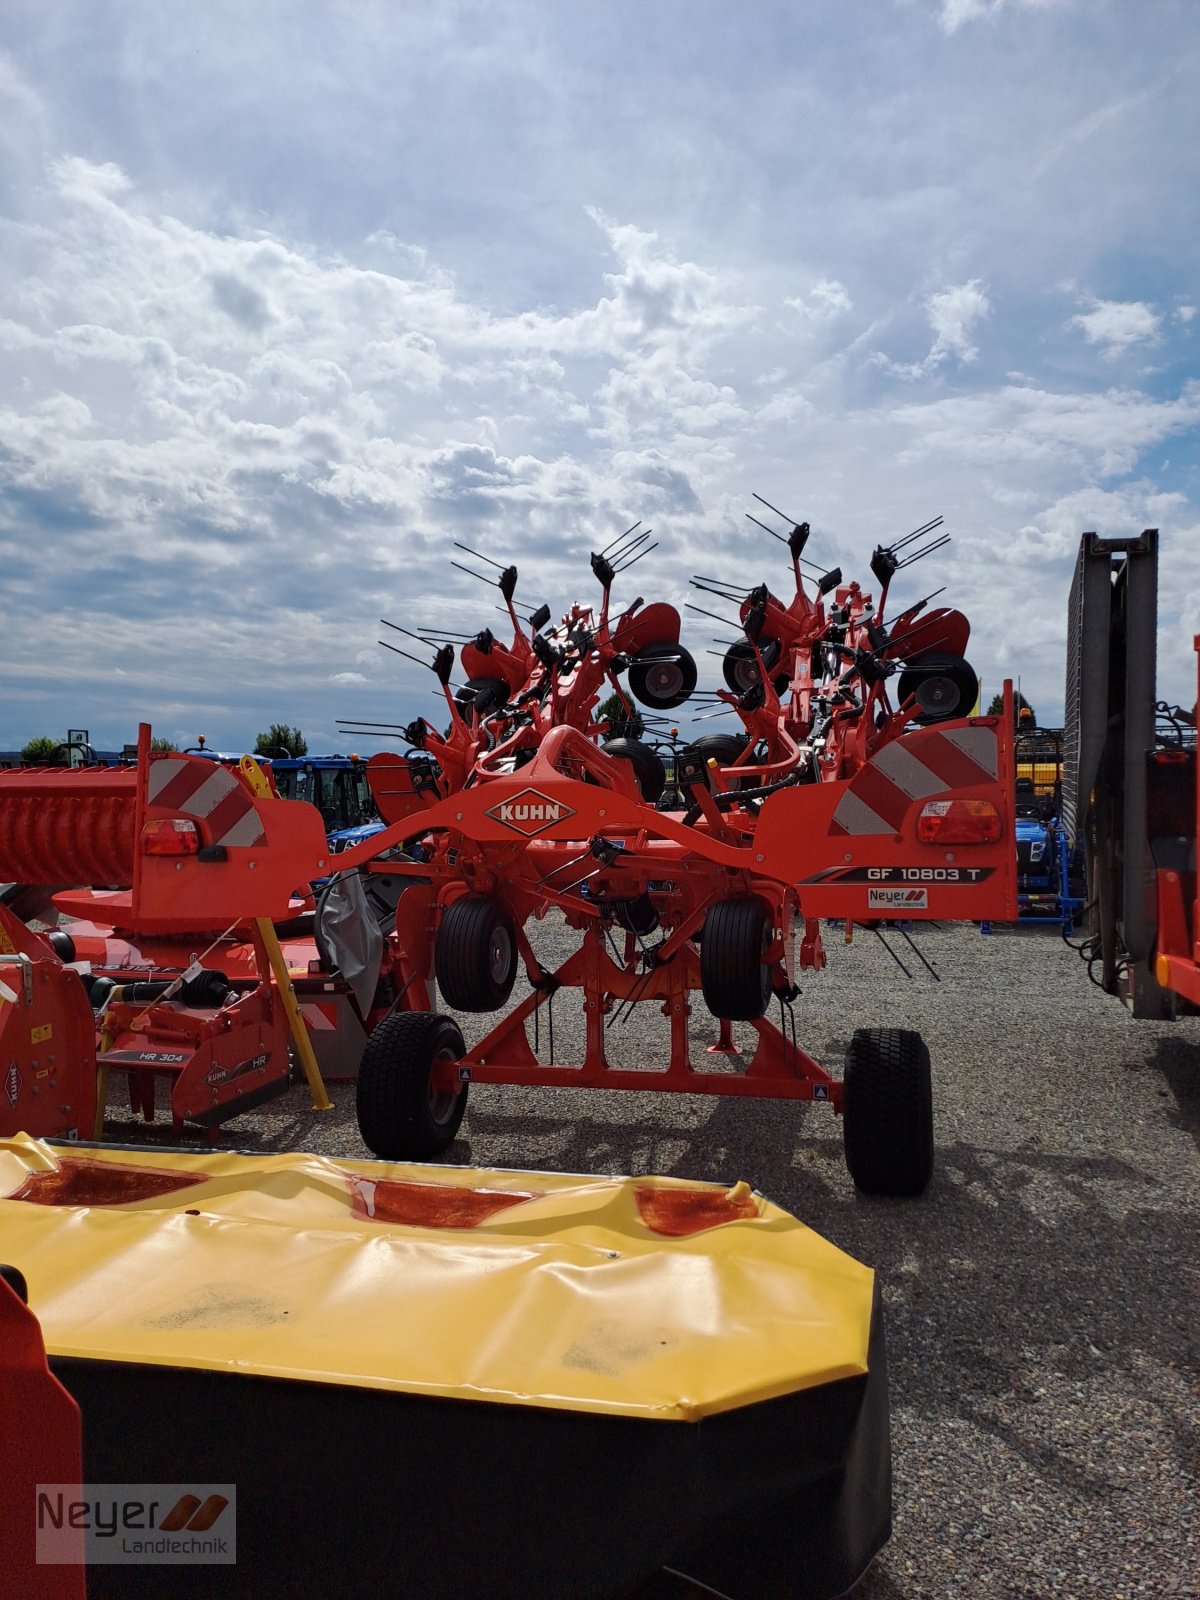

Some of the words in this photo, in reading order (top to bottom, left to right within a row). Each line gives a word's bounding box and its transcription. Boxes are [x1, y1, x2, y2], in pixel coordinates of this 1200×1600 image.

[500, 804, 560, 820] KUHN
[867, 868, 893, 880] GF
[901, 868, 960, 881] 10803
[966, 868, 981, 880] T
[870, 889, 905, 903] Neyer
[139, 1052, 157, 1060] HR
[160, 1053, 183, 1062] 304
[252, 1055, 266, 1069] HR
[207, 1070, 227, 1083] KUHN
[10, 1067, 18, 1101] KUHN
